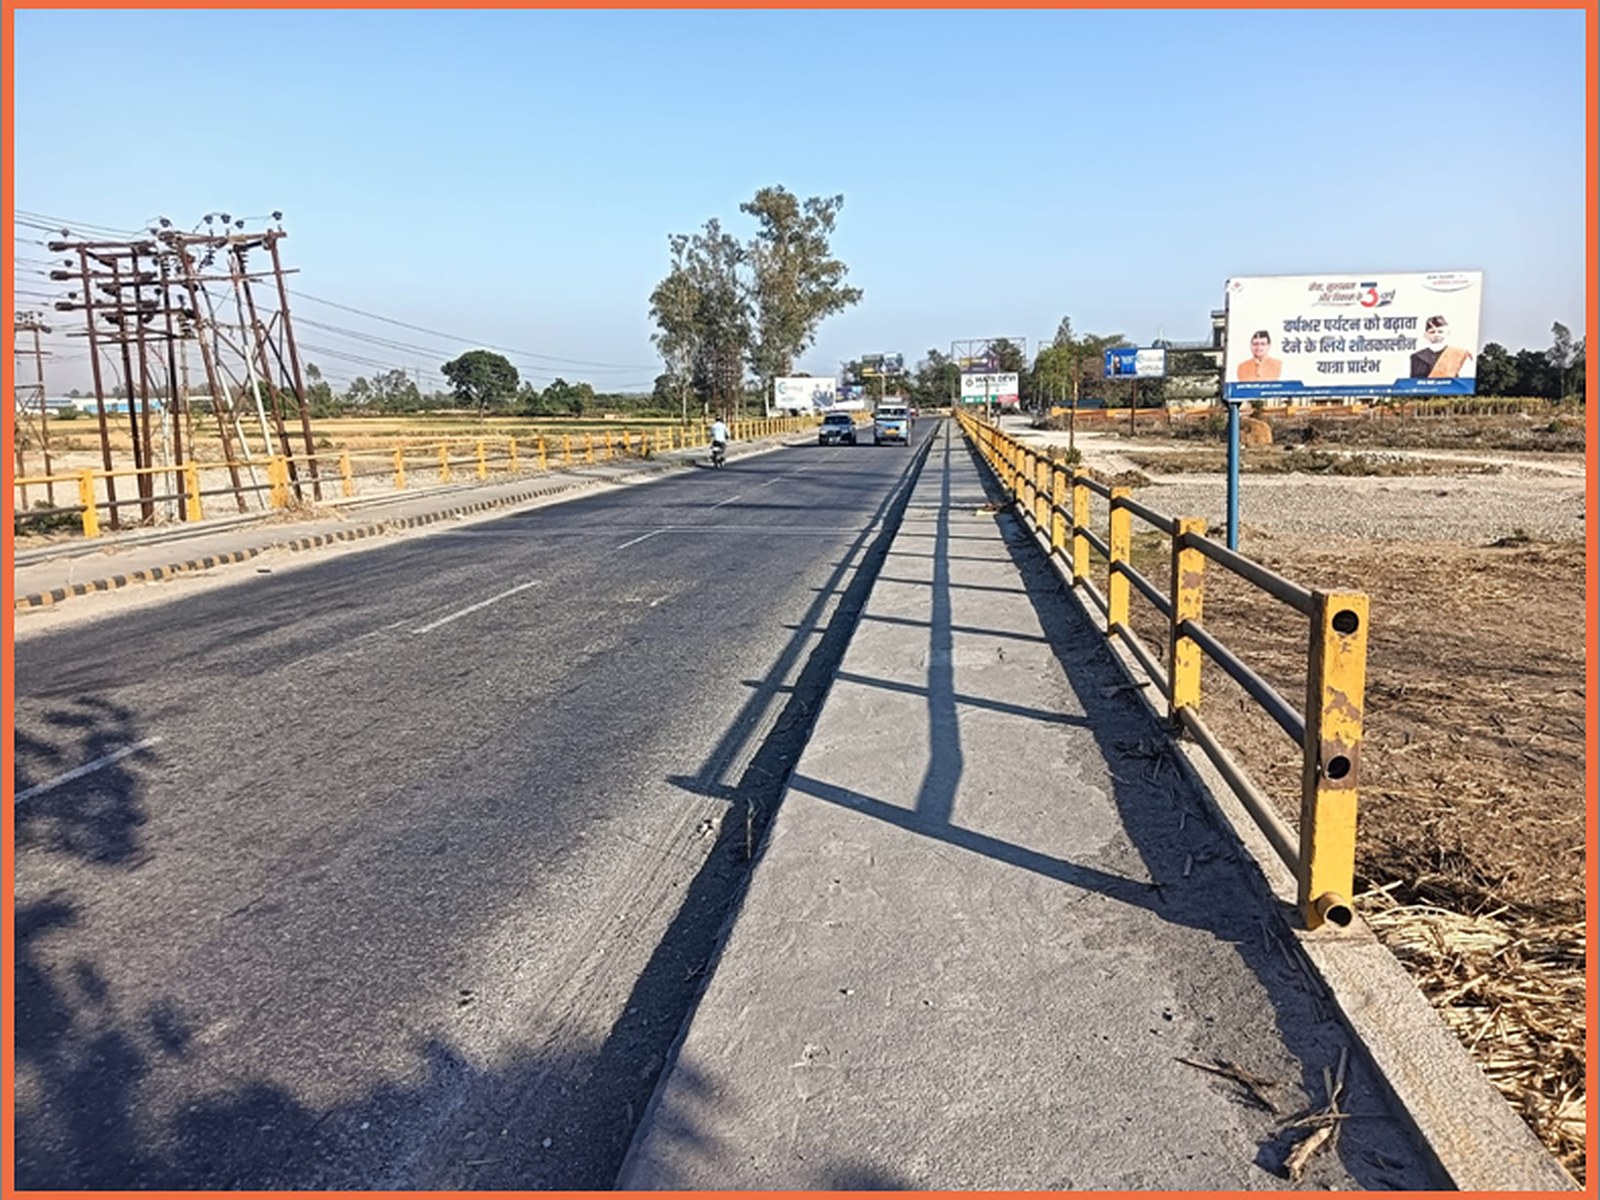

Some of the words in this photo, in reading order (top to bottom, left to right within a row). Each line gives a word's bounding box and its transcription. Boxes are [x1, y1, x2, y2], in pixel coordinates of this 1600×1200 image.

[1283, 315, 1320, 332] वर्षभर
[1323, 314, 1361, 331] पर्यटन
[1363, 313, 1380, 331] को
[1382, 316, 1418, 334] बढ़ावा
[1281, 337, 1302, 354] देने
[1304, 337, 1317, 353] के
[1319, 335, 1346, 353] लिये
[1348, 334, 1417, 352] शीतकालीन
[1316, 360, 1344, 374] यात्रा
[1346, 356, 1381, 373] प्रारंभ
